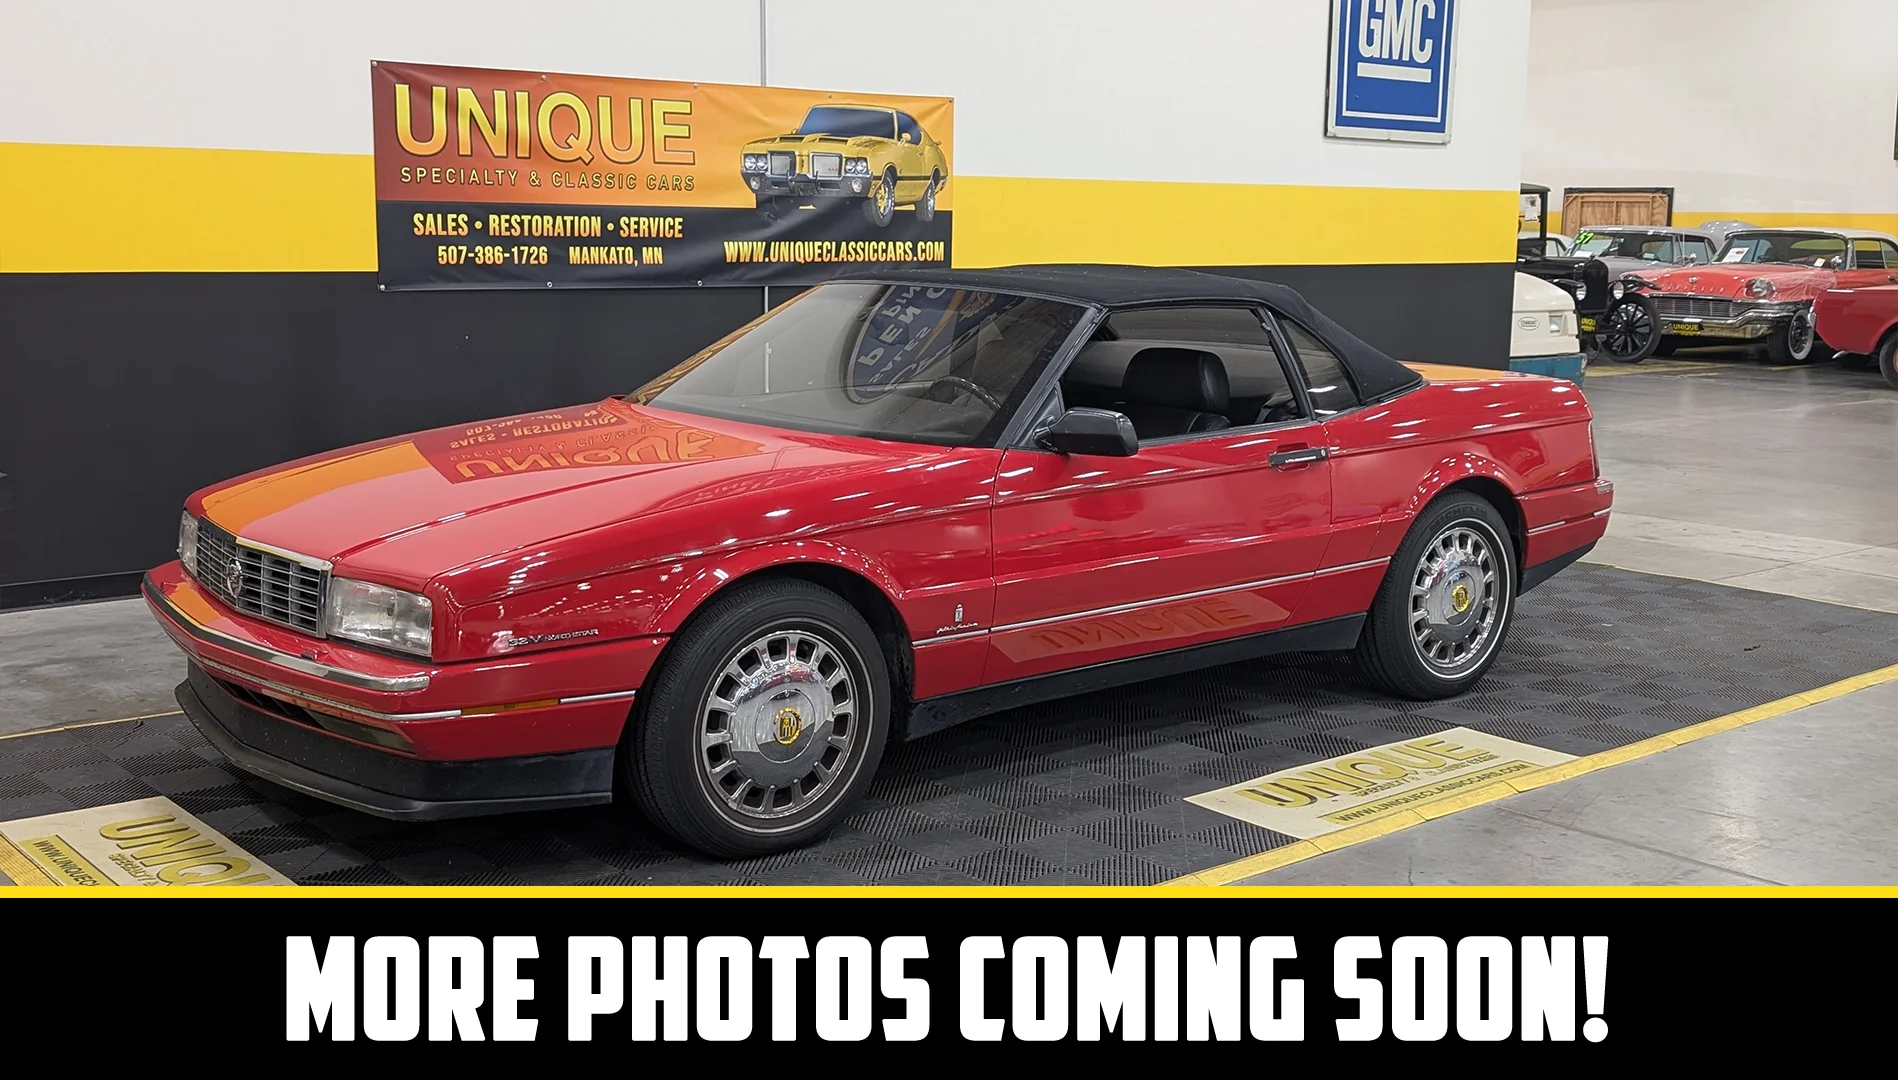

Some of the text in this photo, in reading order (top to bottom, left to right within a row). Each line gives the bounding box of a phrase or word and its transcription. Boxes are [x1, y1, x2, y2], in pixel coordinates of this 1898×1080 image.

[1358, 0, 1436, 64] GMC
[394, 83, 695, 166] UNIQUE
[401, 167, 695, 192] SPECIALTY & CLASSIC CARS
[413, 213, 683, 239] SALES RESTORATION SERVICE
[437, 245, 664, 268] 507-386-1726 MANKATO, MN
[724, 241, 944, 264] WWW.UNIQUECLASSICCARS.COM
[1673, 323, 1699, 331] UNIQUE
[1236, 737, 1490, 808] UNIQUE
